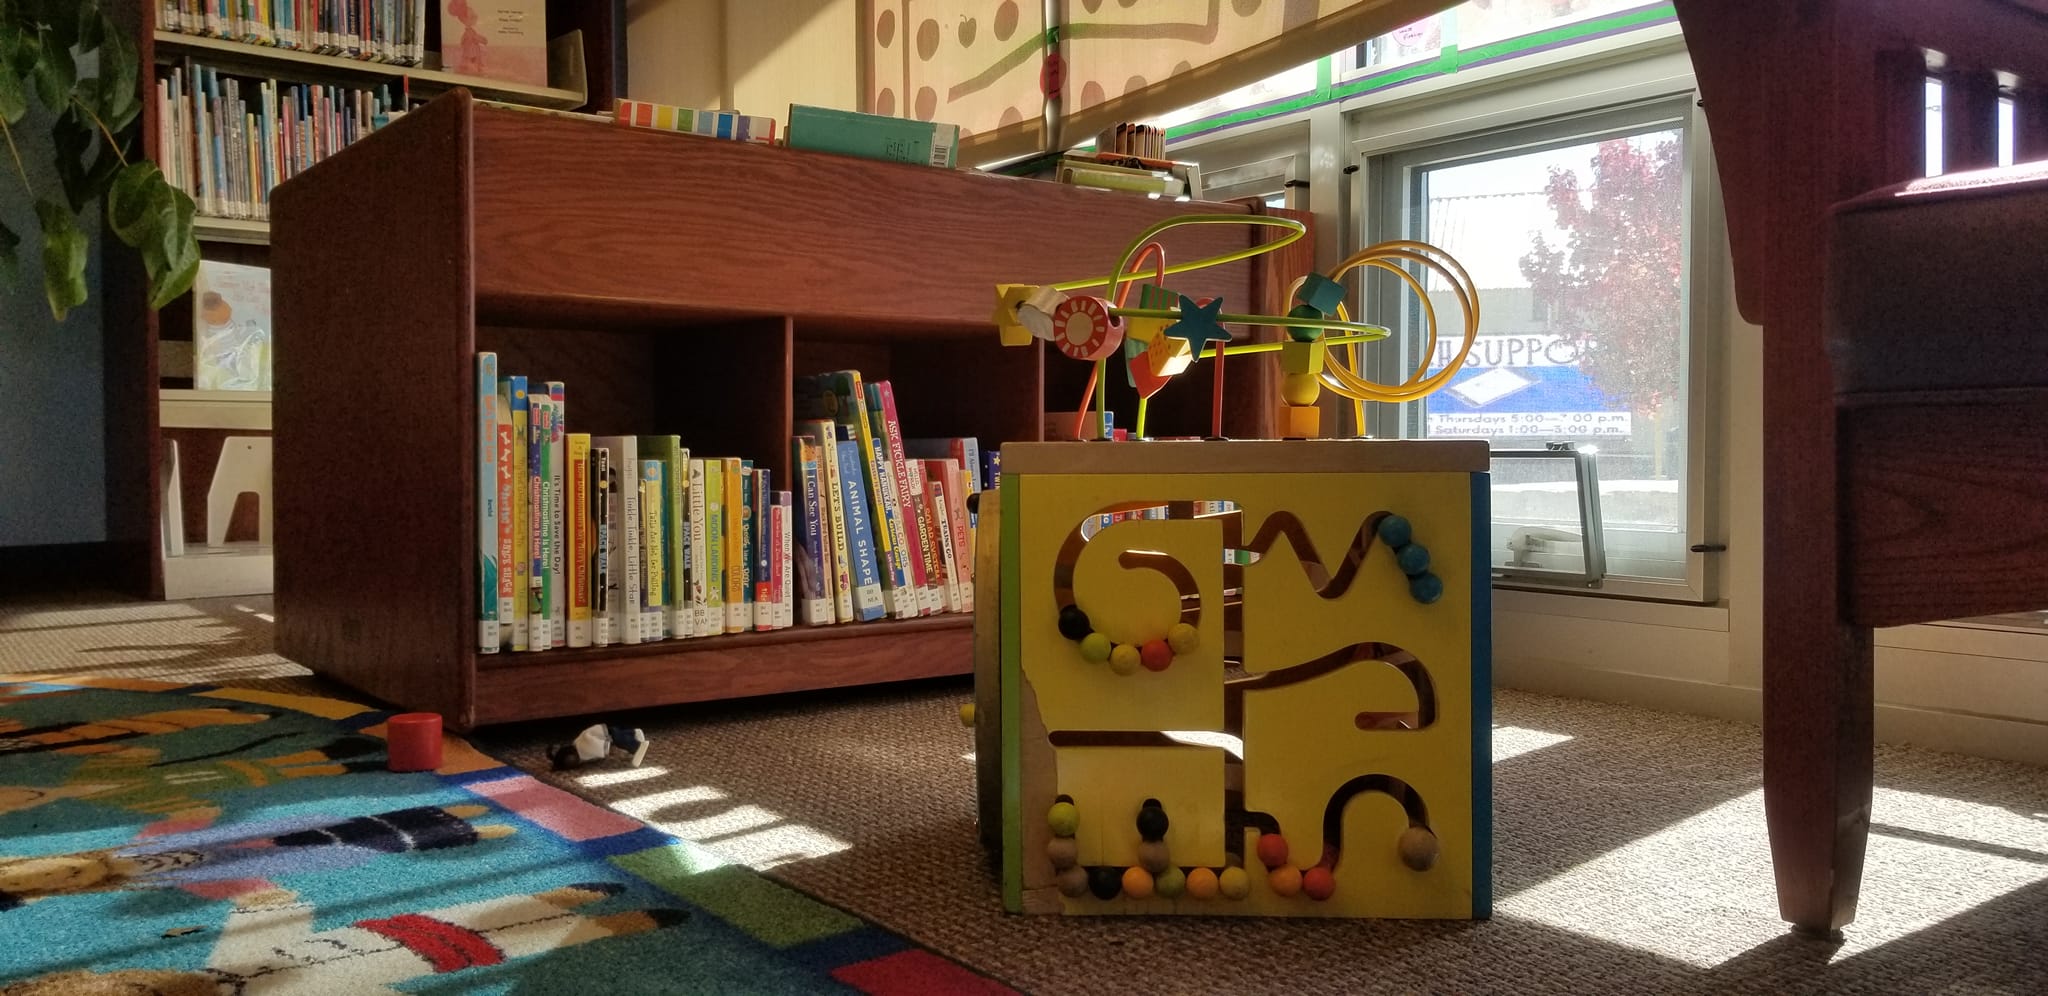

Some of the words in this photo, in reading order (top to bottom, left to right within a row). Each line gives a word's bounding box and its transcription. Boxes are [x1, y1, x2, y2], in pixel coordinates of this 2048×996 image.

[888, 420, 898, 440] ASK
[1436, 425, 1504, 436] Saturdays
[1593, 426, 1624, 435] p.m.
[1440, 414, 1506, 424] Thursdays
[874, 446, 884, 469] HAPPY
[892, 442, 906, 477] FICKLE
[578, 480, 584, 492] Do
[808, 480, 816, 498] Can
[900, 478, 912, 508] FAIRY
[627, 496, 636, 522] Tinkle,
[692, 483, 703, 515] Little
[808, 501, 817, 517] See
[848, 481, 864, 534] ANIMAL
[554, 510, 560, 518] to
[832, 482, 840, 512] LET'S
[836, 515, 844, 550] BUILD
[925, 508, 934, 538] SOLAR
[628, 526, 637, 553] Tinkle,
[692, 518, 704, 542] You
[810, 520, 818, 536] You
[942, 520, 950, 547] TRAINS
[946, 548, 952, 558] GO
[957, 526, 966, 546] PETS
[918, 516, 930, 551] GARDEN
[924, 552, 933, 574] TIME
[552, 556, 560, 574] Day!
[628, 556, 638, 582] Little
[502, 567, 513, 593] SHACK
[629, 584, 638, 605] Star
